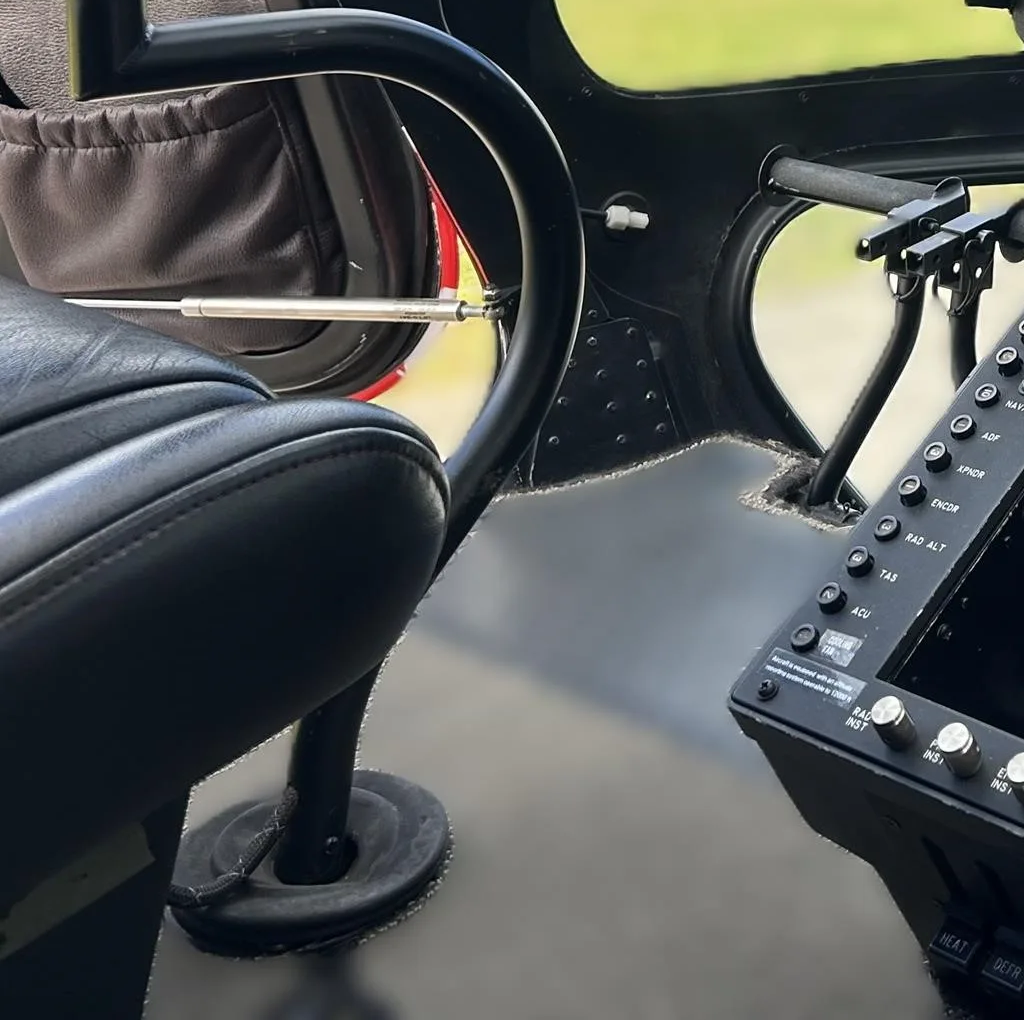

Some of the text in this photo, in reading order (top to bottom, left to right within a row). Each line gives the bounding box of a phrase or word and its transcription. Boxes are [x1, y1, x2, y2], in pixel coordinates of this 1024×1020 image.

[982, 432, 1001, 442] ADF
[957, 465, 986, 480] XPNDR
[931, 499, 960, 514] ENCDR
[905, 533, 946, 552] RAD ALT
[879, 570, 898, 582] TAS
[851, 606, 871, 619] ACU
[845, 717, 869, 732] INST
[940, 933, 968, 954] HEAT
[994, 958, 1022, 979] DEFR
